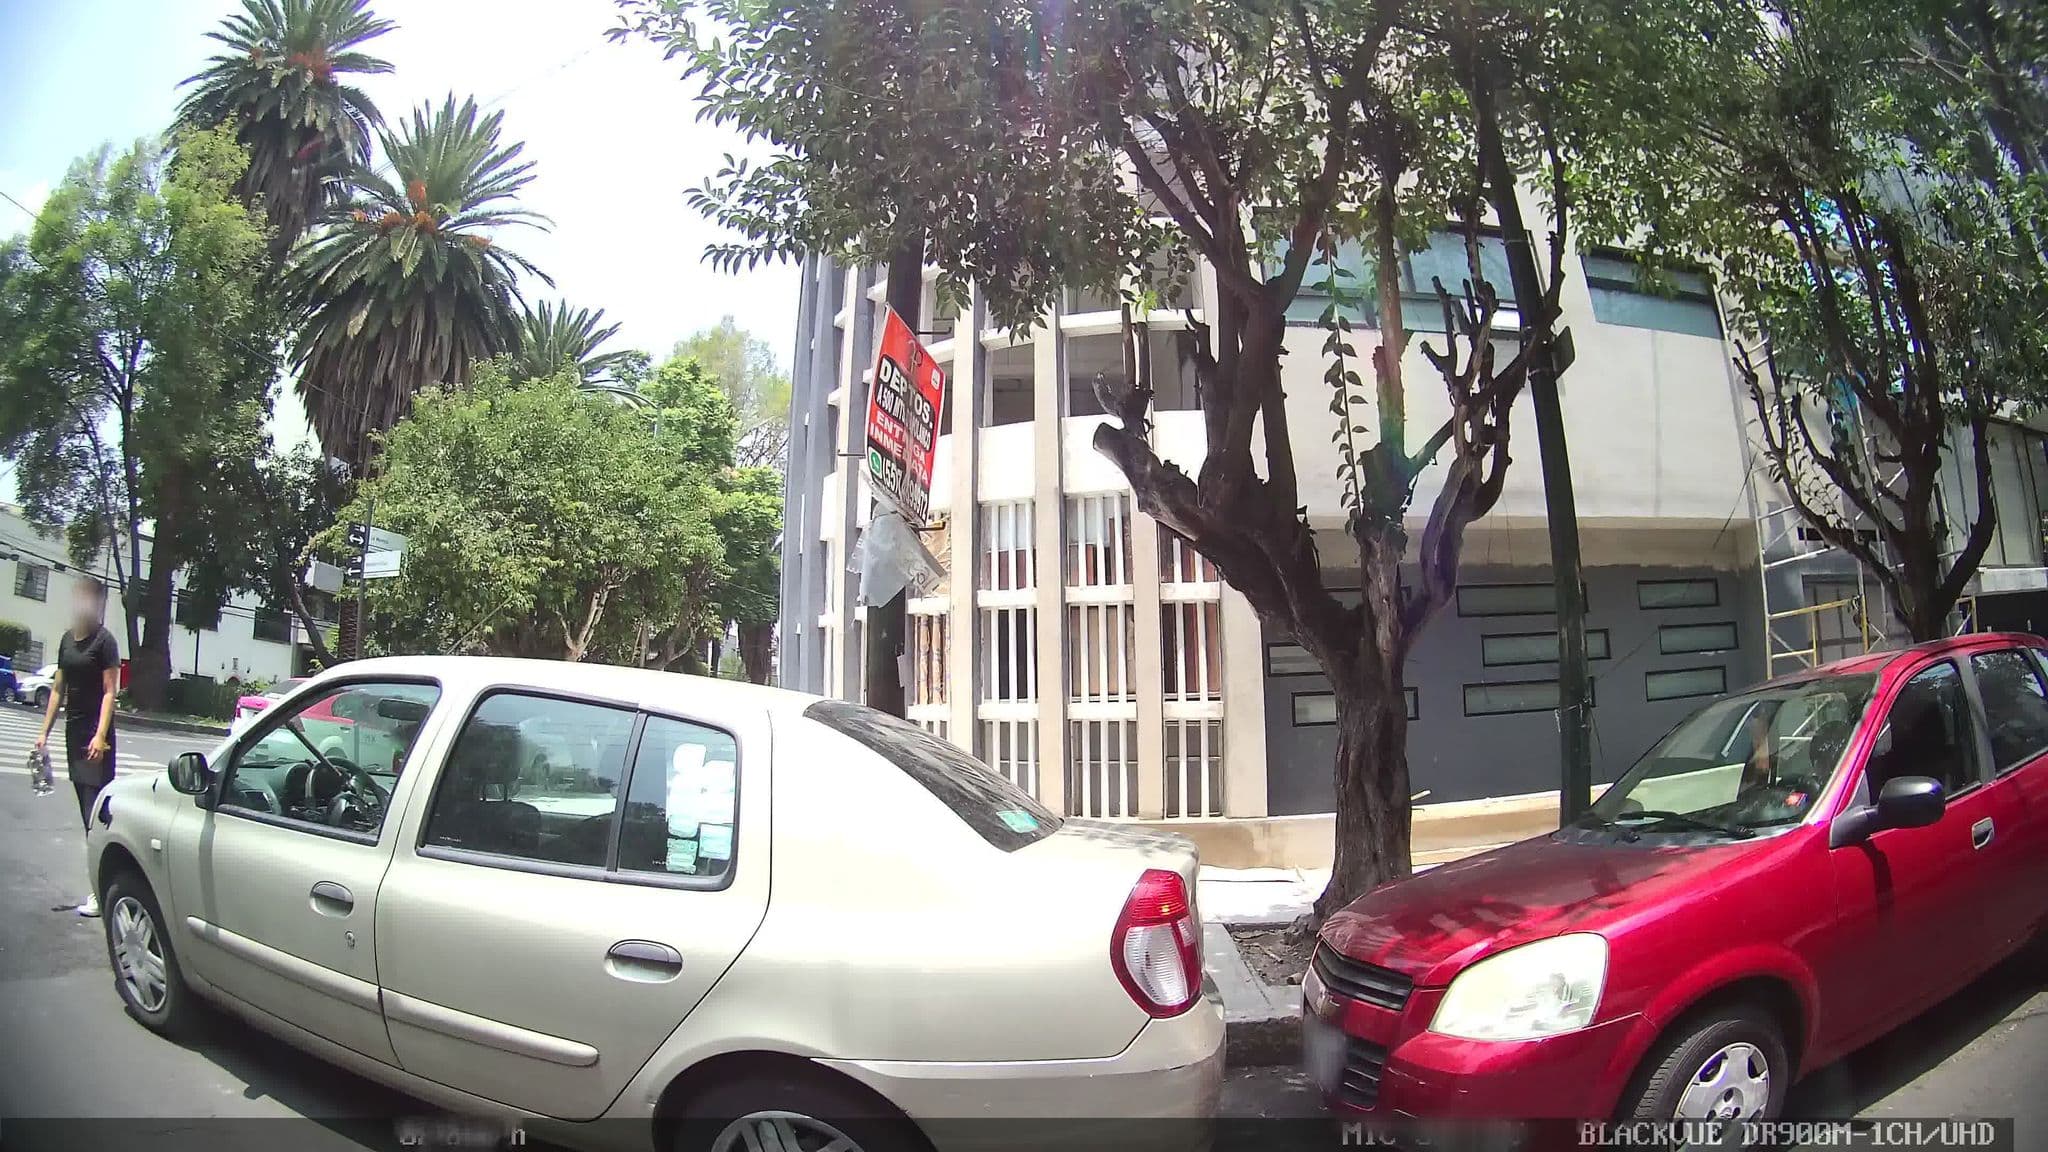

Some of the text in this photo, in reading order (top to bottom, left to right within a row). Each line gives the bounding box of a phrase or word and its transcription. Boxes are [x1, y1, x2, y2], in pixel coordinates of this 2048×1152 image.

[880, 358, 933, 429] DEPTOS.
[870, 423, 929, 485] INMEDATA
[876, 411, 926, 464] ENTGA
